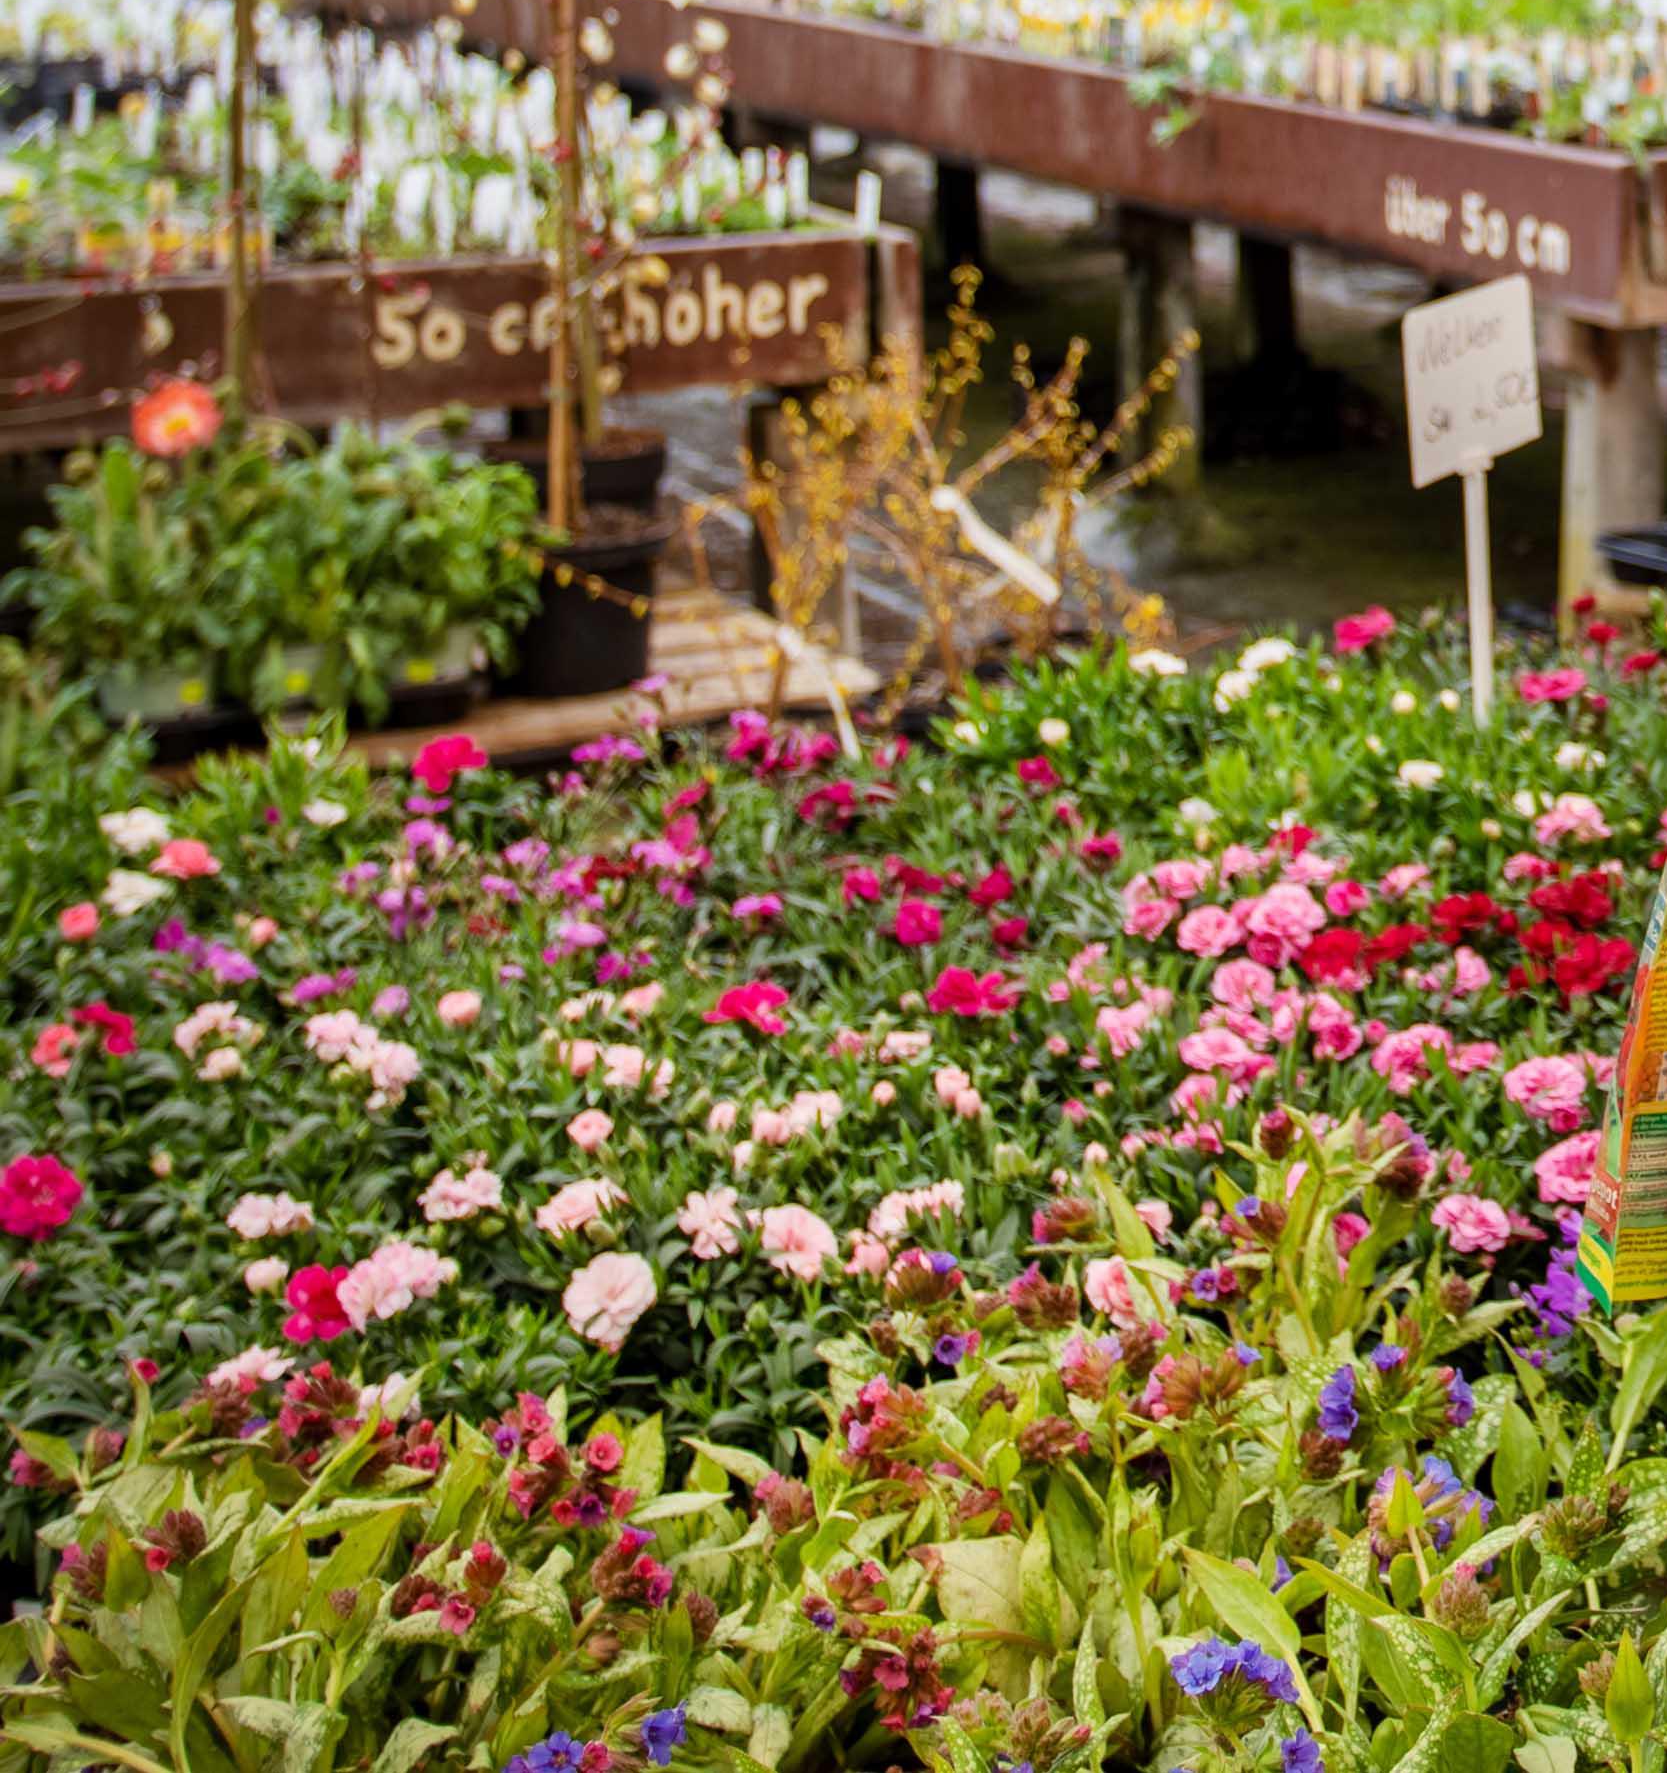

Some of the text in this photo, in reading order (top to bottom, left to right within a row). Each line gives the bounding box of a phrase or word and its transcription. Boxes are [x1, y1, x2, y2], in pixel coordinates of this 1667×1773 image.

[1384, 177, 1570, 274] über 50 cm
[371, 288, 466, 370] 50
